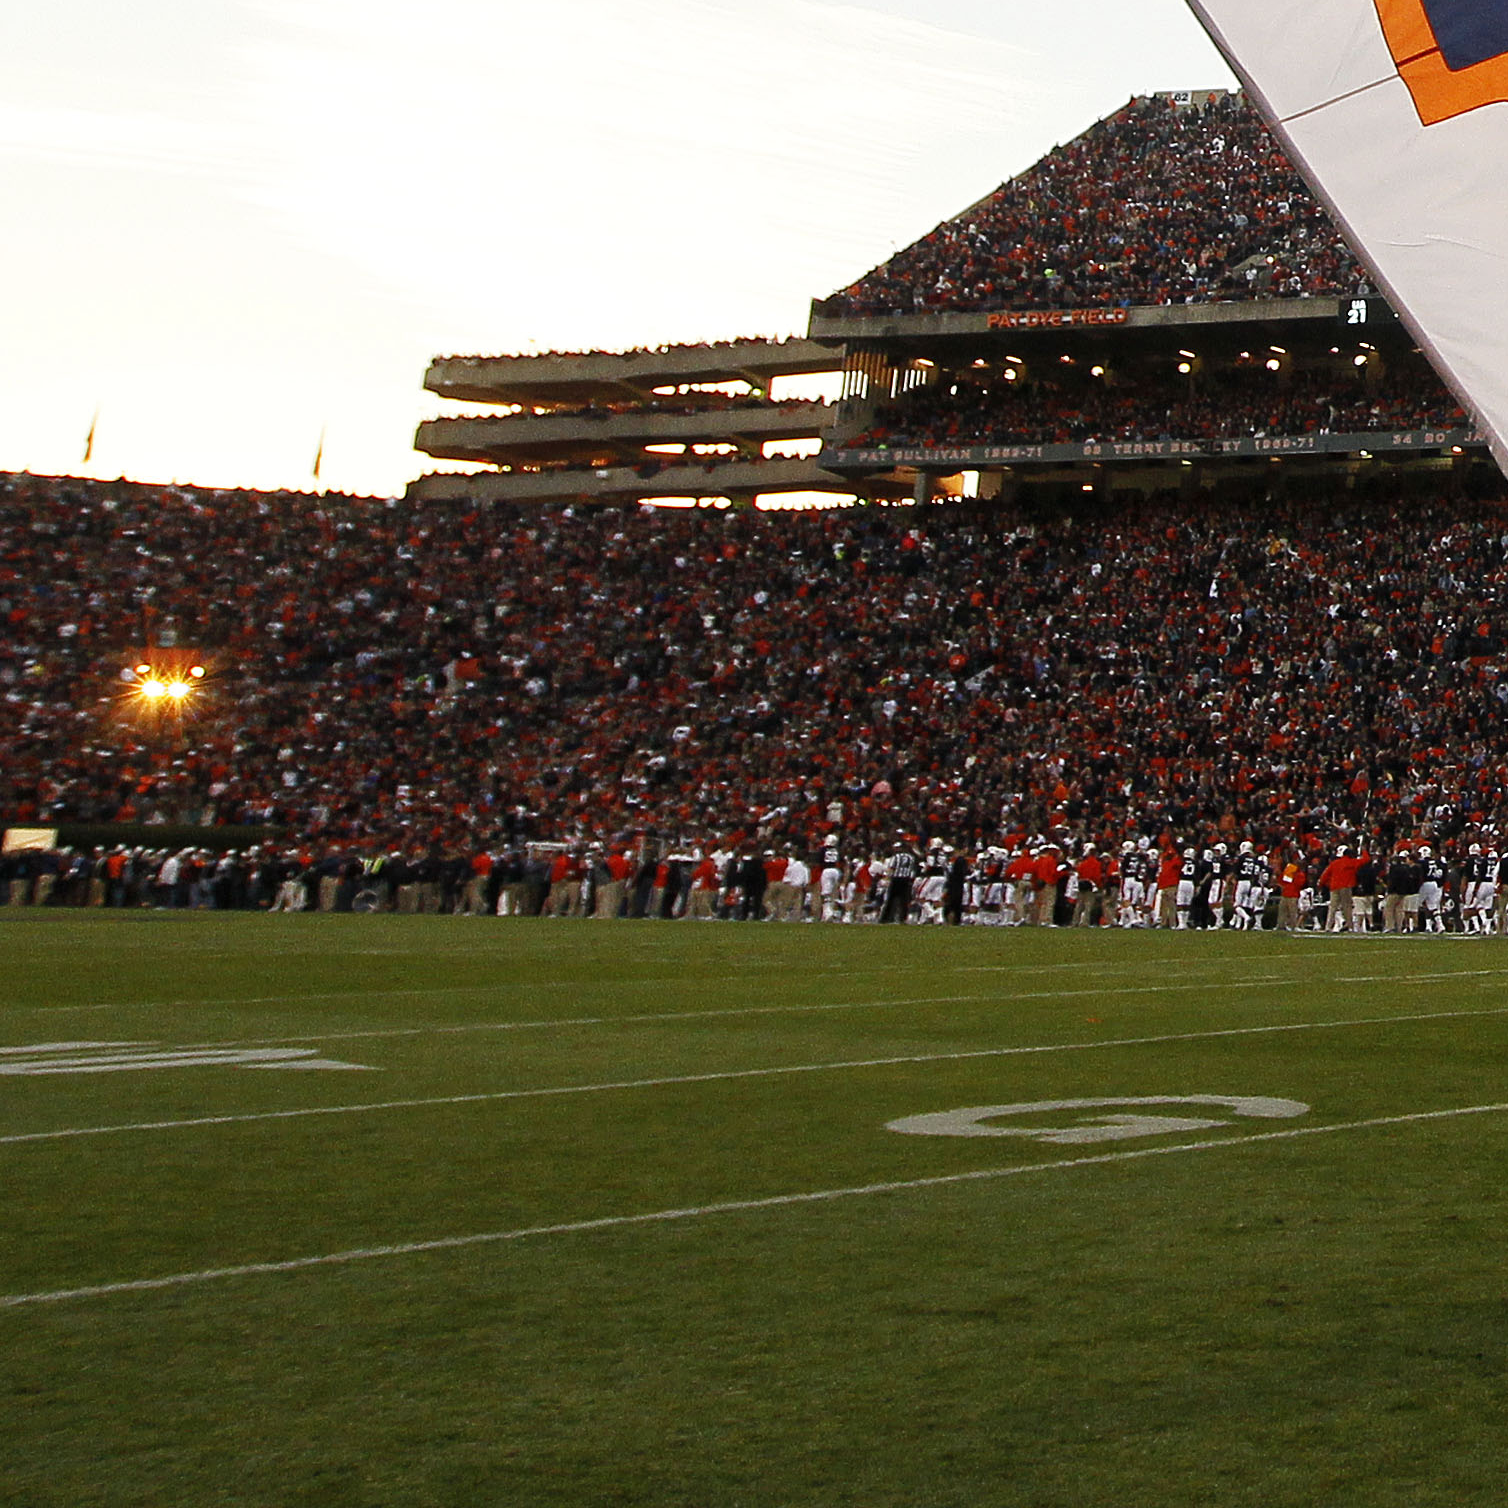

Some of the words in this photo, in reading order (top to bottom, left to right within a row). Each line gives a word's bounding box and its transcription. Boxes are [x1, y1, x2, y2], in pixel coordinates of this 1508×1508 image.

[986, 312, 1019, 328] PAT
[1026, 311, 1062, 327] DYE
[1070, 308, 1128, 324] FIELD
[1347, 308, 1367, 323] 21
